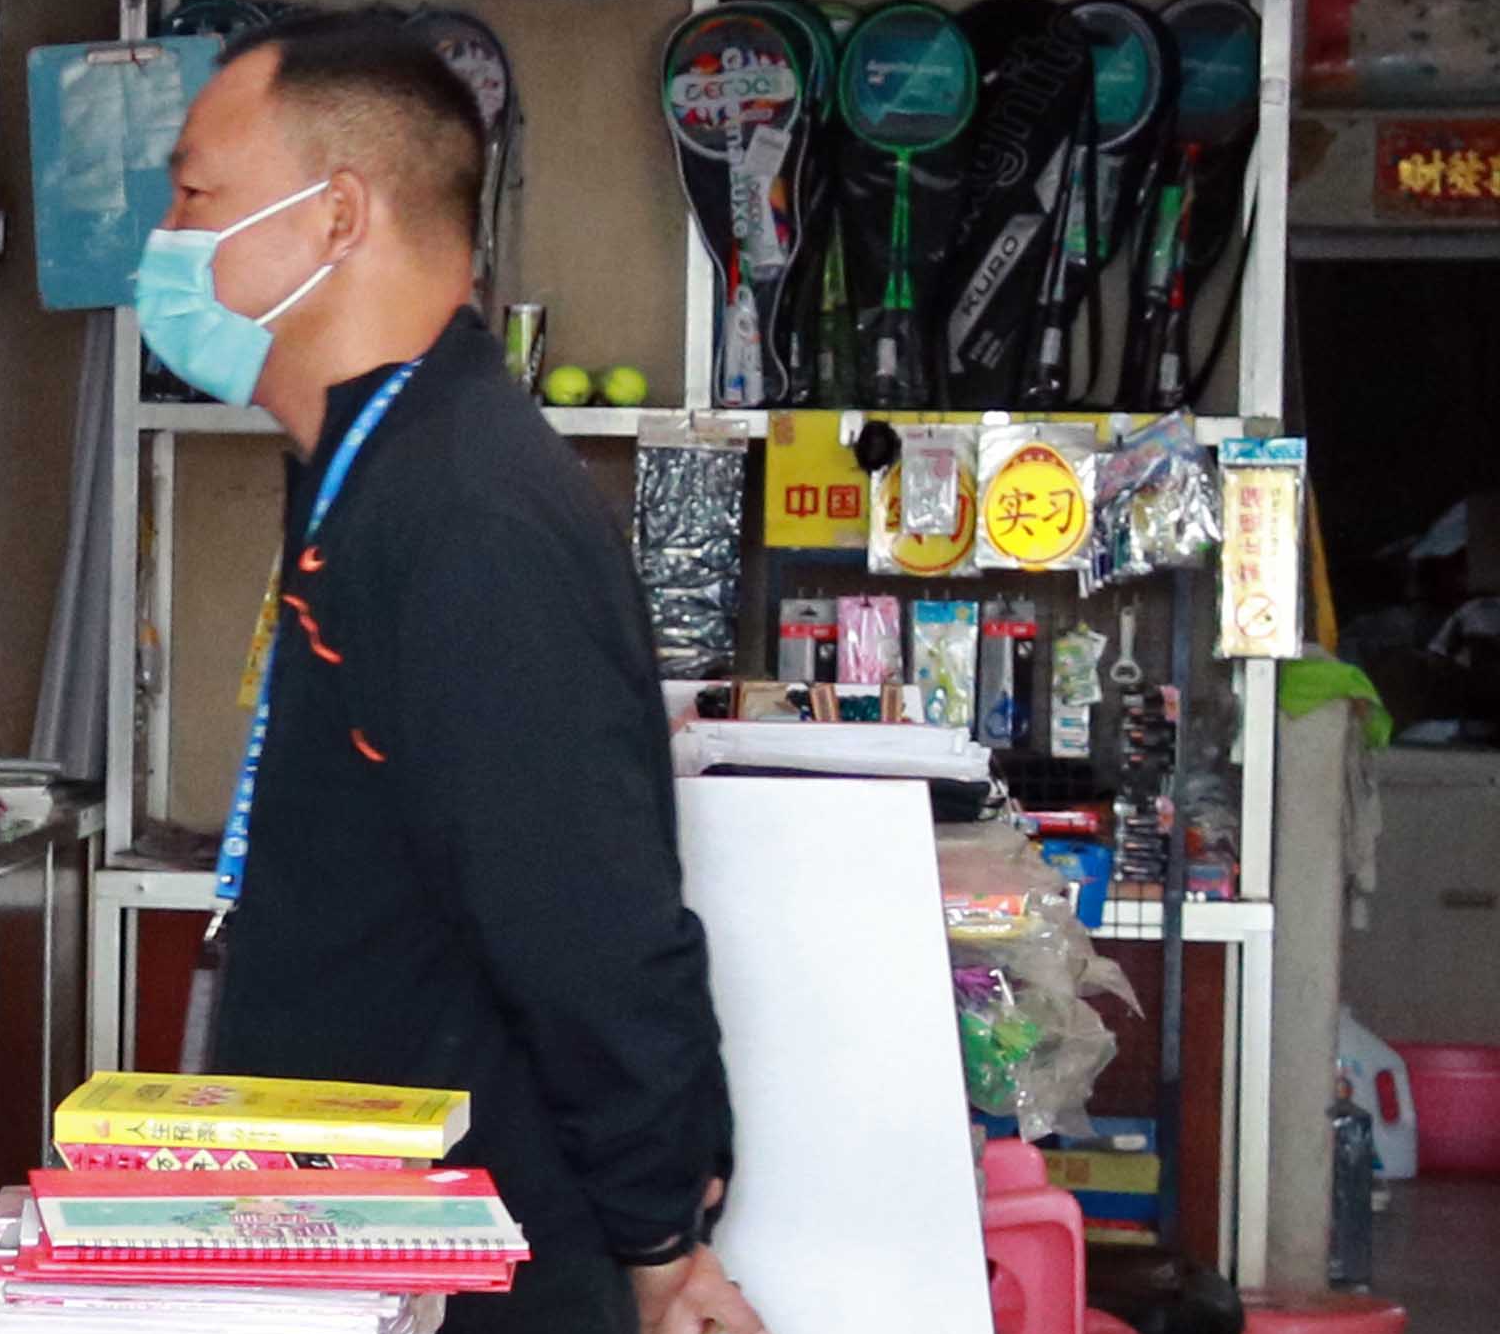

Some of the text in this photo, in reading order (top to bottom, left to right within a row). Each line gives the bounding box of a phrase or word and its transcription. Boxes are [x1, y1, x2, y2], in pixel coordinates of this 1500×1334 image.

[960, 234, 1019, 316] KURO
[785, 483, 861, 520] 中国
[994, 487, 1078, 537] 实习
